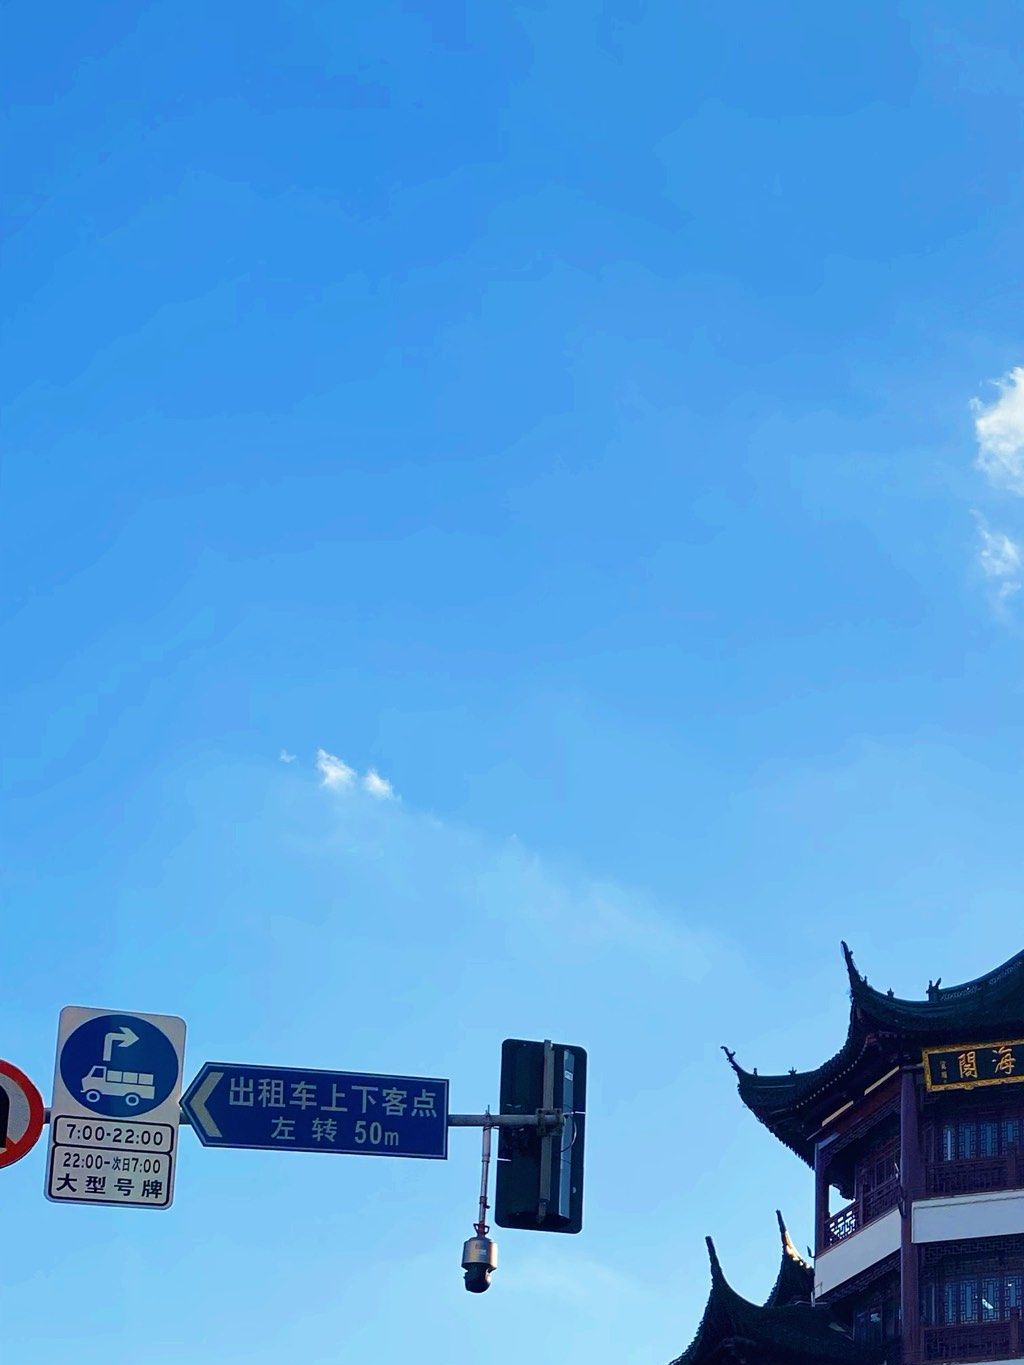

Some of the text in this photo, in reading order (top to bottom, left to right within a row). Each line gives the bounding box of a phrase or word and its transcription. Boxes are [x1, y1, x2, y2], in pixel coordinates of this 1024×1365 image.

[227, 1076, 438, 1119] 出租车上下客点
[66, 1123, 165, 1148] 7:00-22:00
[354, 1119, 400, 1148] 50m
[62, 1152, 162, 1176] 22:00-次日7:00
[55, 1172, 164, 1201] 大型号牌
